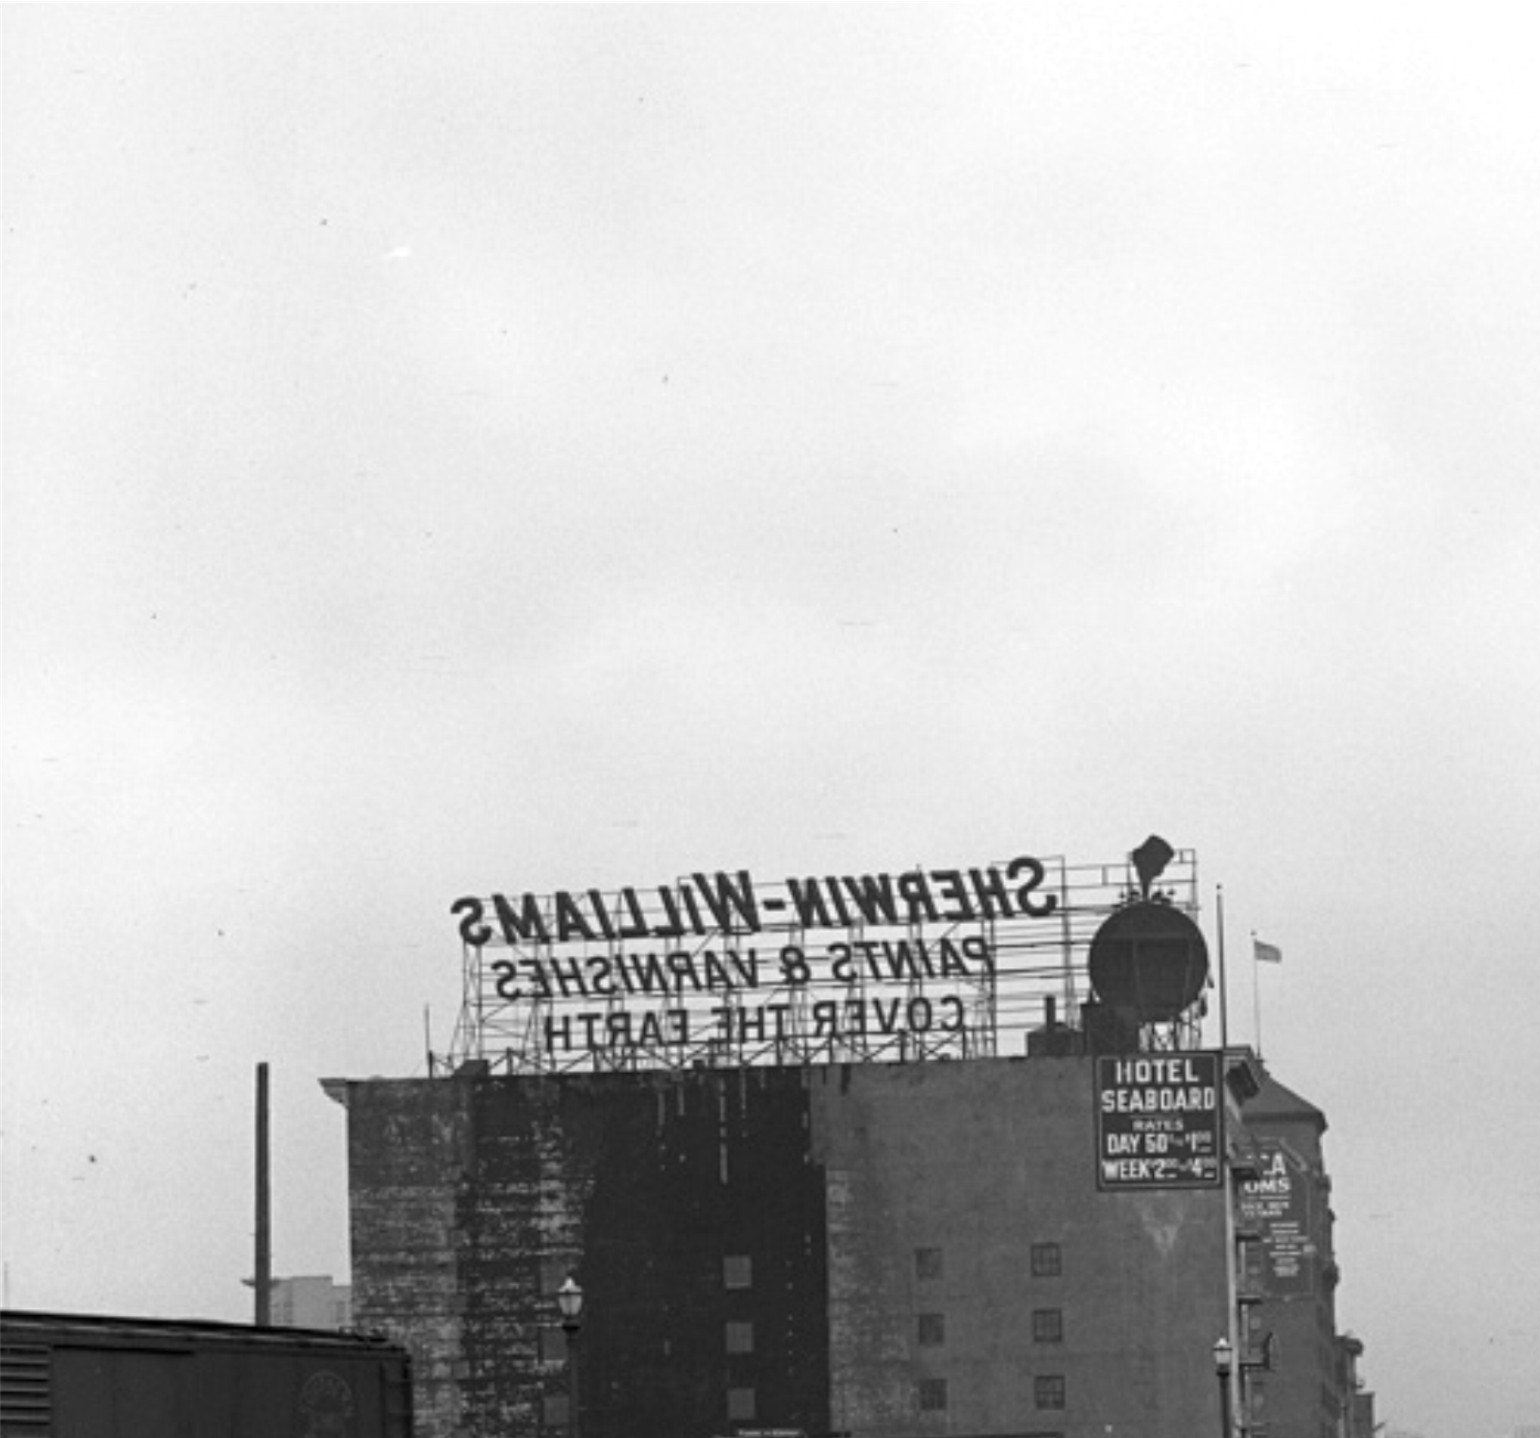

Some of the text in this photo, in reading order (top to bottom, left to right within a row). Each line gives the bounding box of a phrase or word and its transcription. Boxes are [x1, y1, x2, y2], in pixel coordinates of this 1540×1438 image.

[1116, 1059, 1199, 1084] HOTEL
[1101, 1087, 1214, 1112] SEABOARD
[1108, 1133, 1140, 1154] DAY
[1102, 1158, 1150, 1179] WEEK
